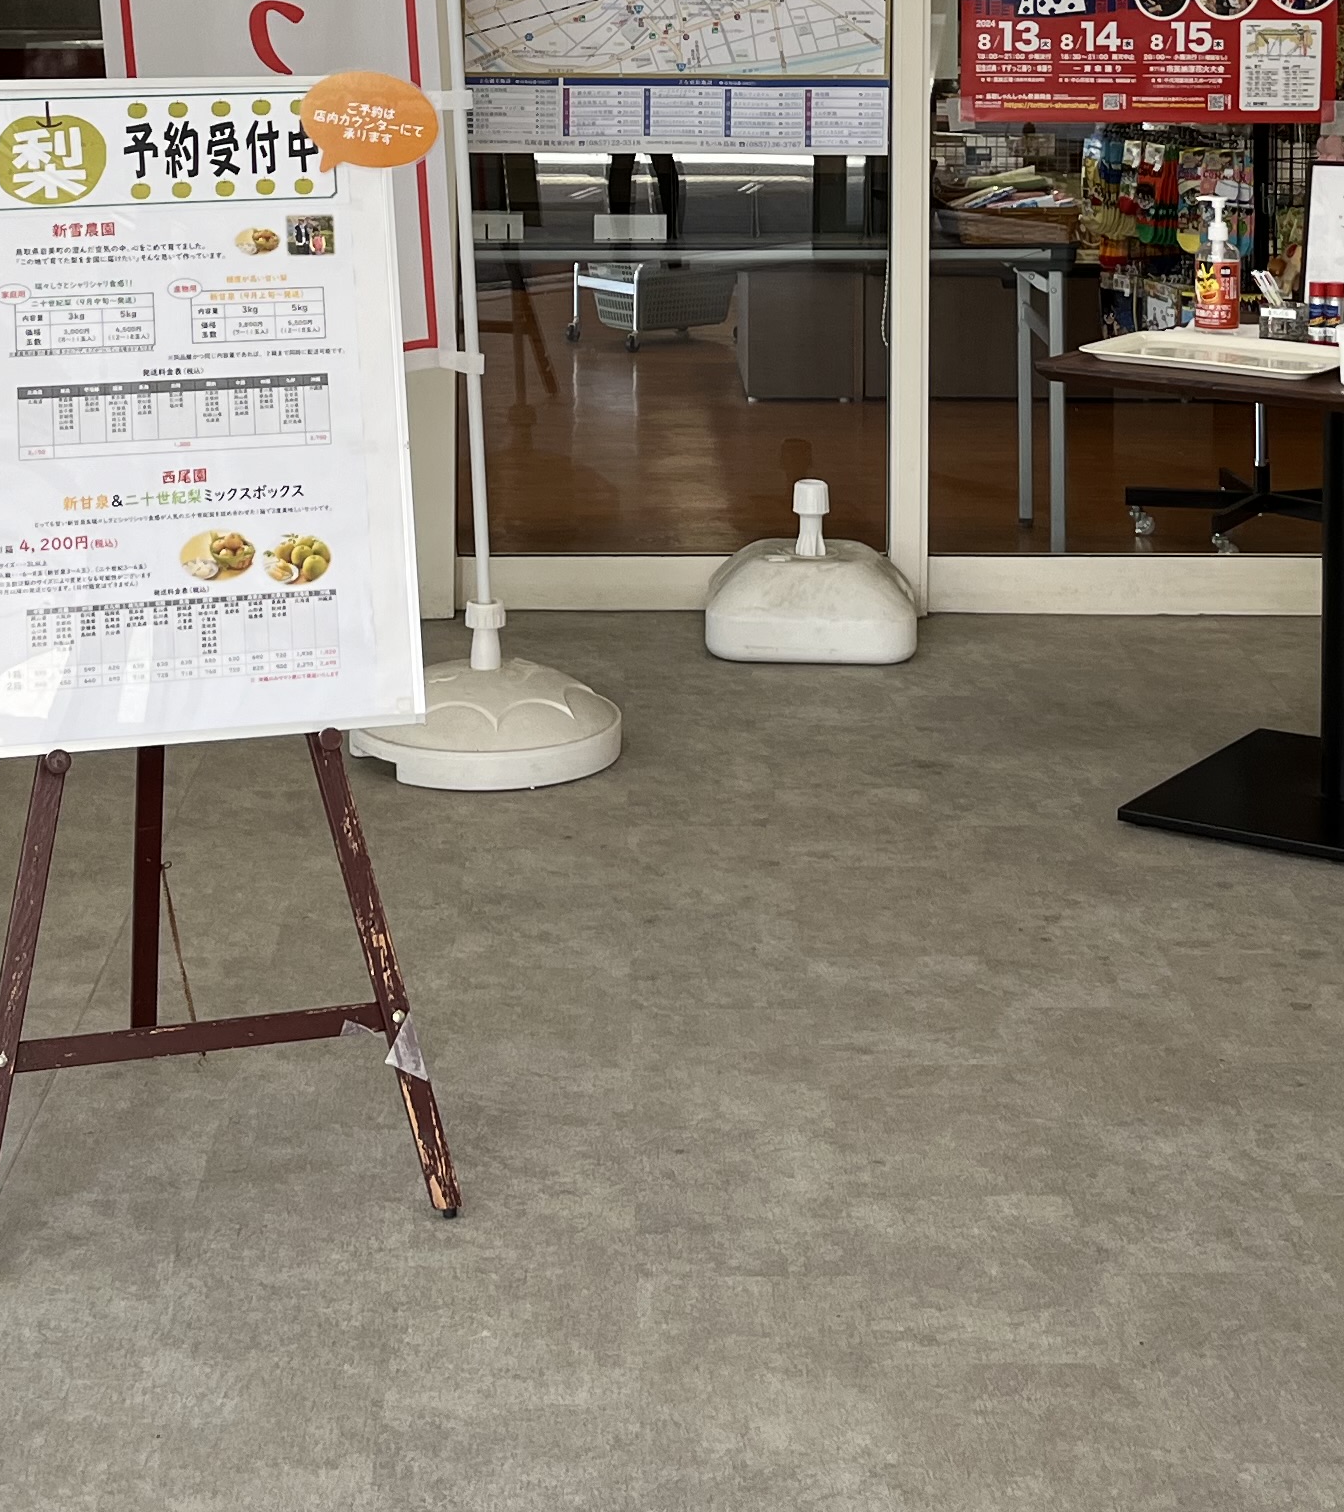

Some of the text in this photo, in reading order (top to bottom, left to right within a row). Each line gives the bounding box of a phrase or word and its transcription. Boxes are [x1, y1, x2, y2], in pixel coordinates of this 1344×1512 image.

[975, 19, 996, 28] 2024
[977, 20, 1052, 52] 8/13 火
[1060, 21, 1122, 52] 8/14
[1149, 21, 1213, 53] 8/15
[346, 102, 396, 120] ご予約は
[313, 109, 425, 138] 店内カウンターにて
[342, 127, 393, 146] 承ります
[122, 119, 320, 180] 予約受付中
[11, 126, 88, 200] 梨
[52, 221, 116, 239] 新雪農園
[68, 312, 85, 321] 3kg
[120, 310, 137, 319] 5kg
[242, 306, 259, 314] 3kg
[291, 304, 308, 312] 5kg
[162, 467, 207, 484] 西尾園
[63, 484, 305, 512] 新甘泉&二十世紀梨ミックスボックス
